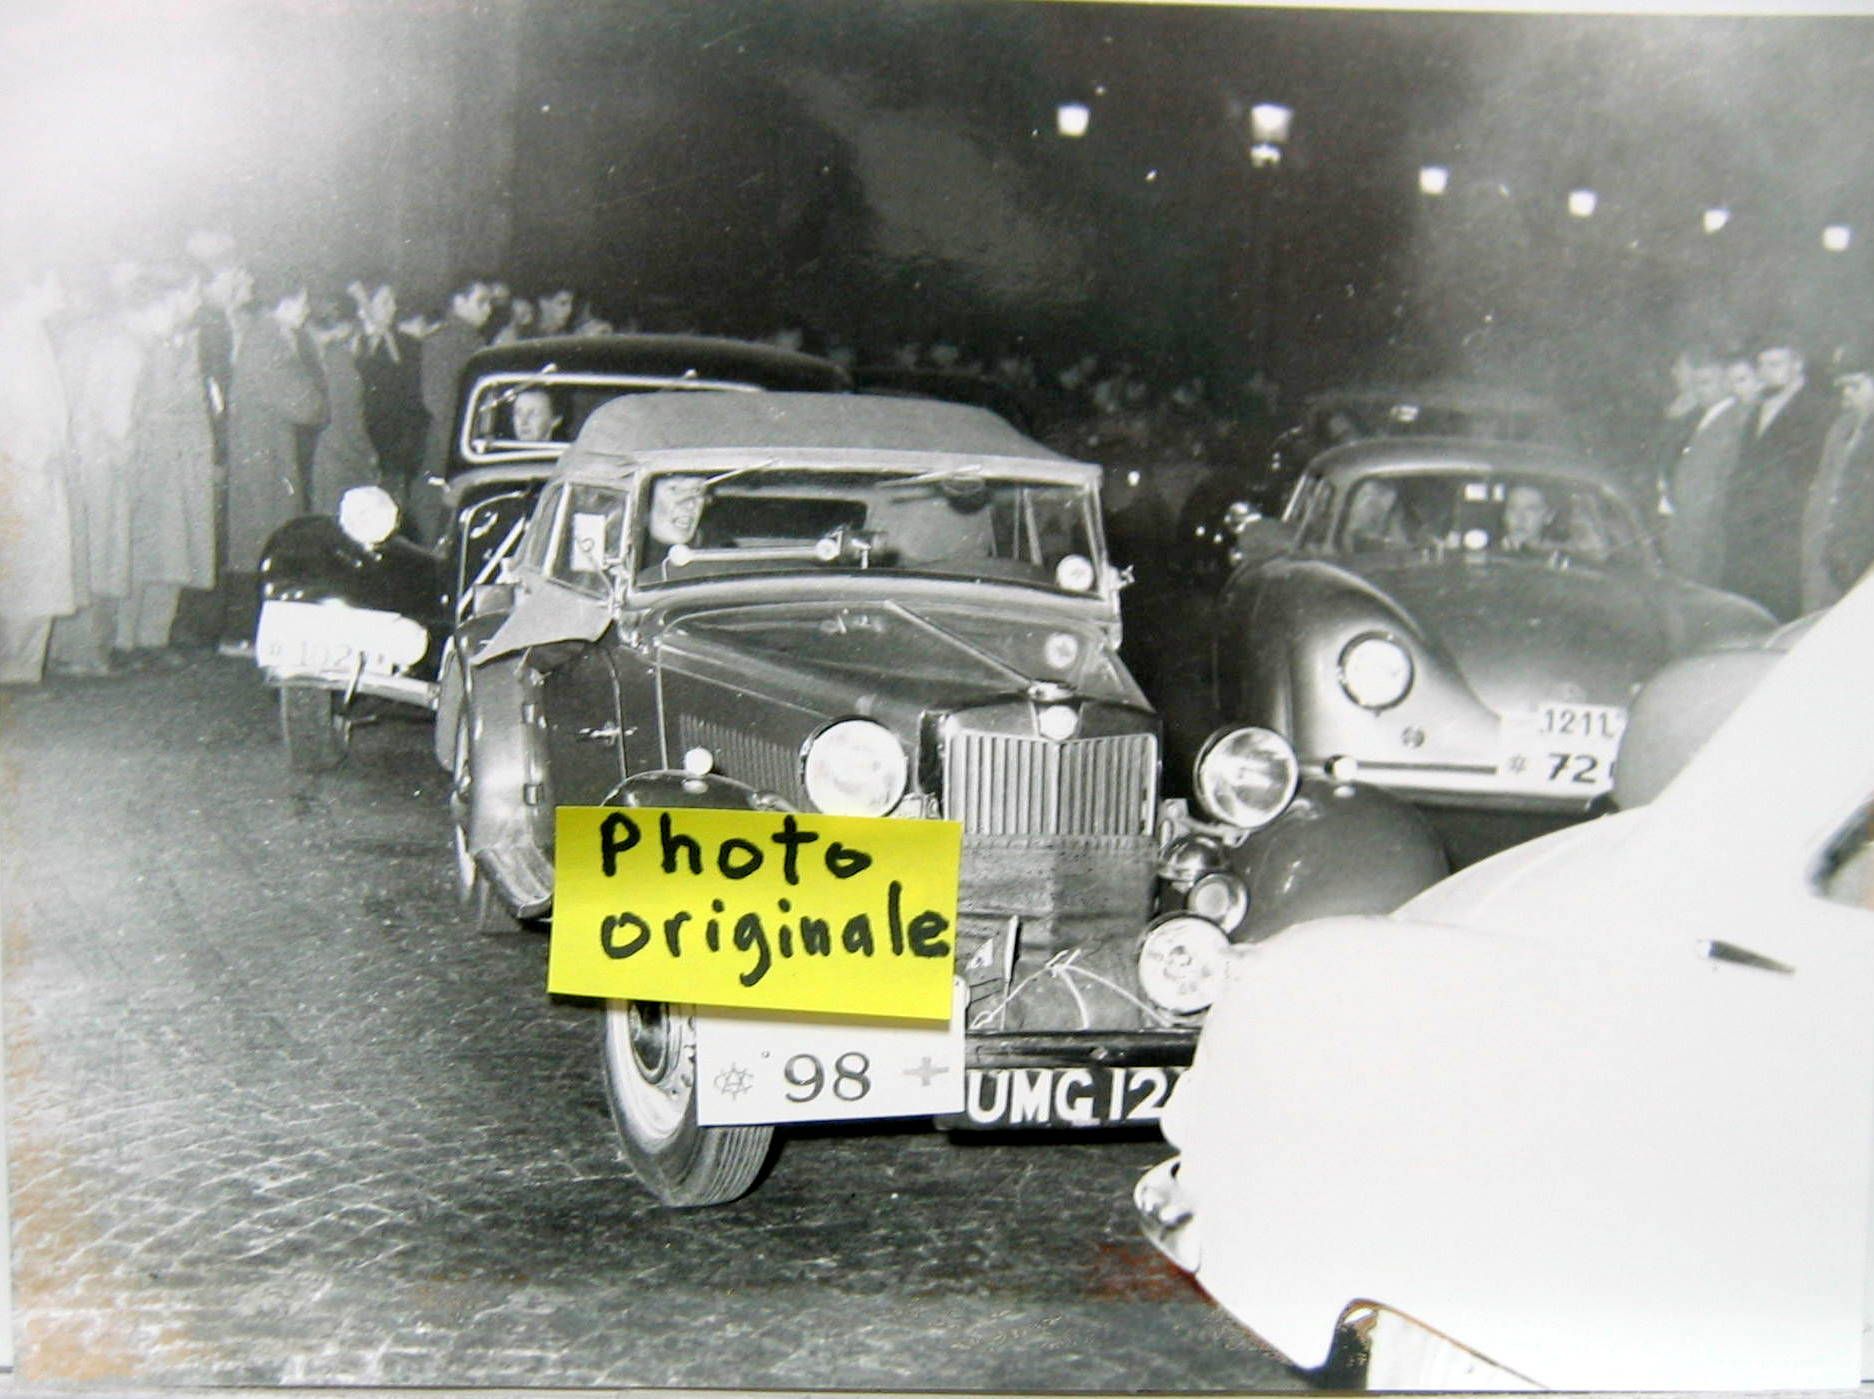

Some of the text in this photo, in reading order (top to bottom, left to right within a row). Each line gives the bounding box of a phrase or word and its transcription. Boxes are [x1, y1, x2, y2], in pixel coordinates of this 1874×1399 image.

[600, 811, 873, 884] Photo
[601, 880, 952, 987] originale
[783, 1051, 873, 1103] 98
[968, 1069, 1099, 1124] UMG
